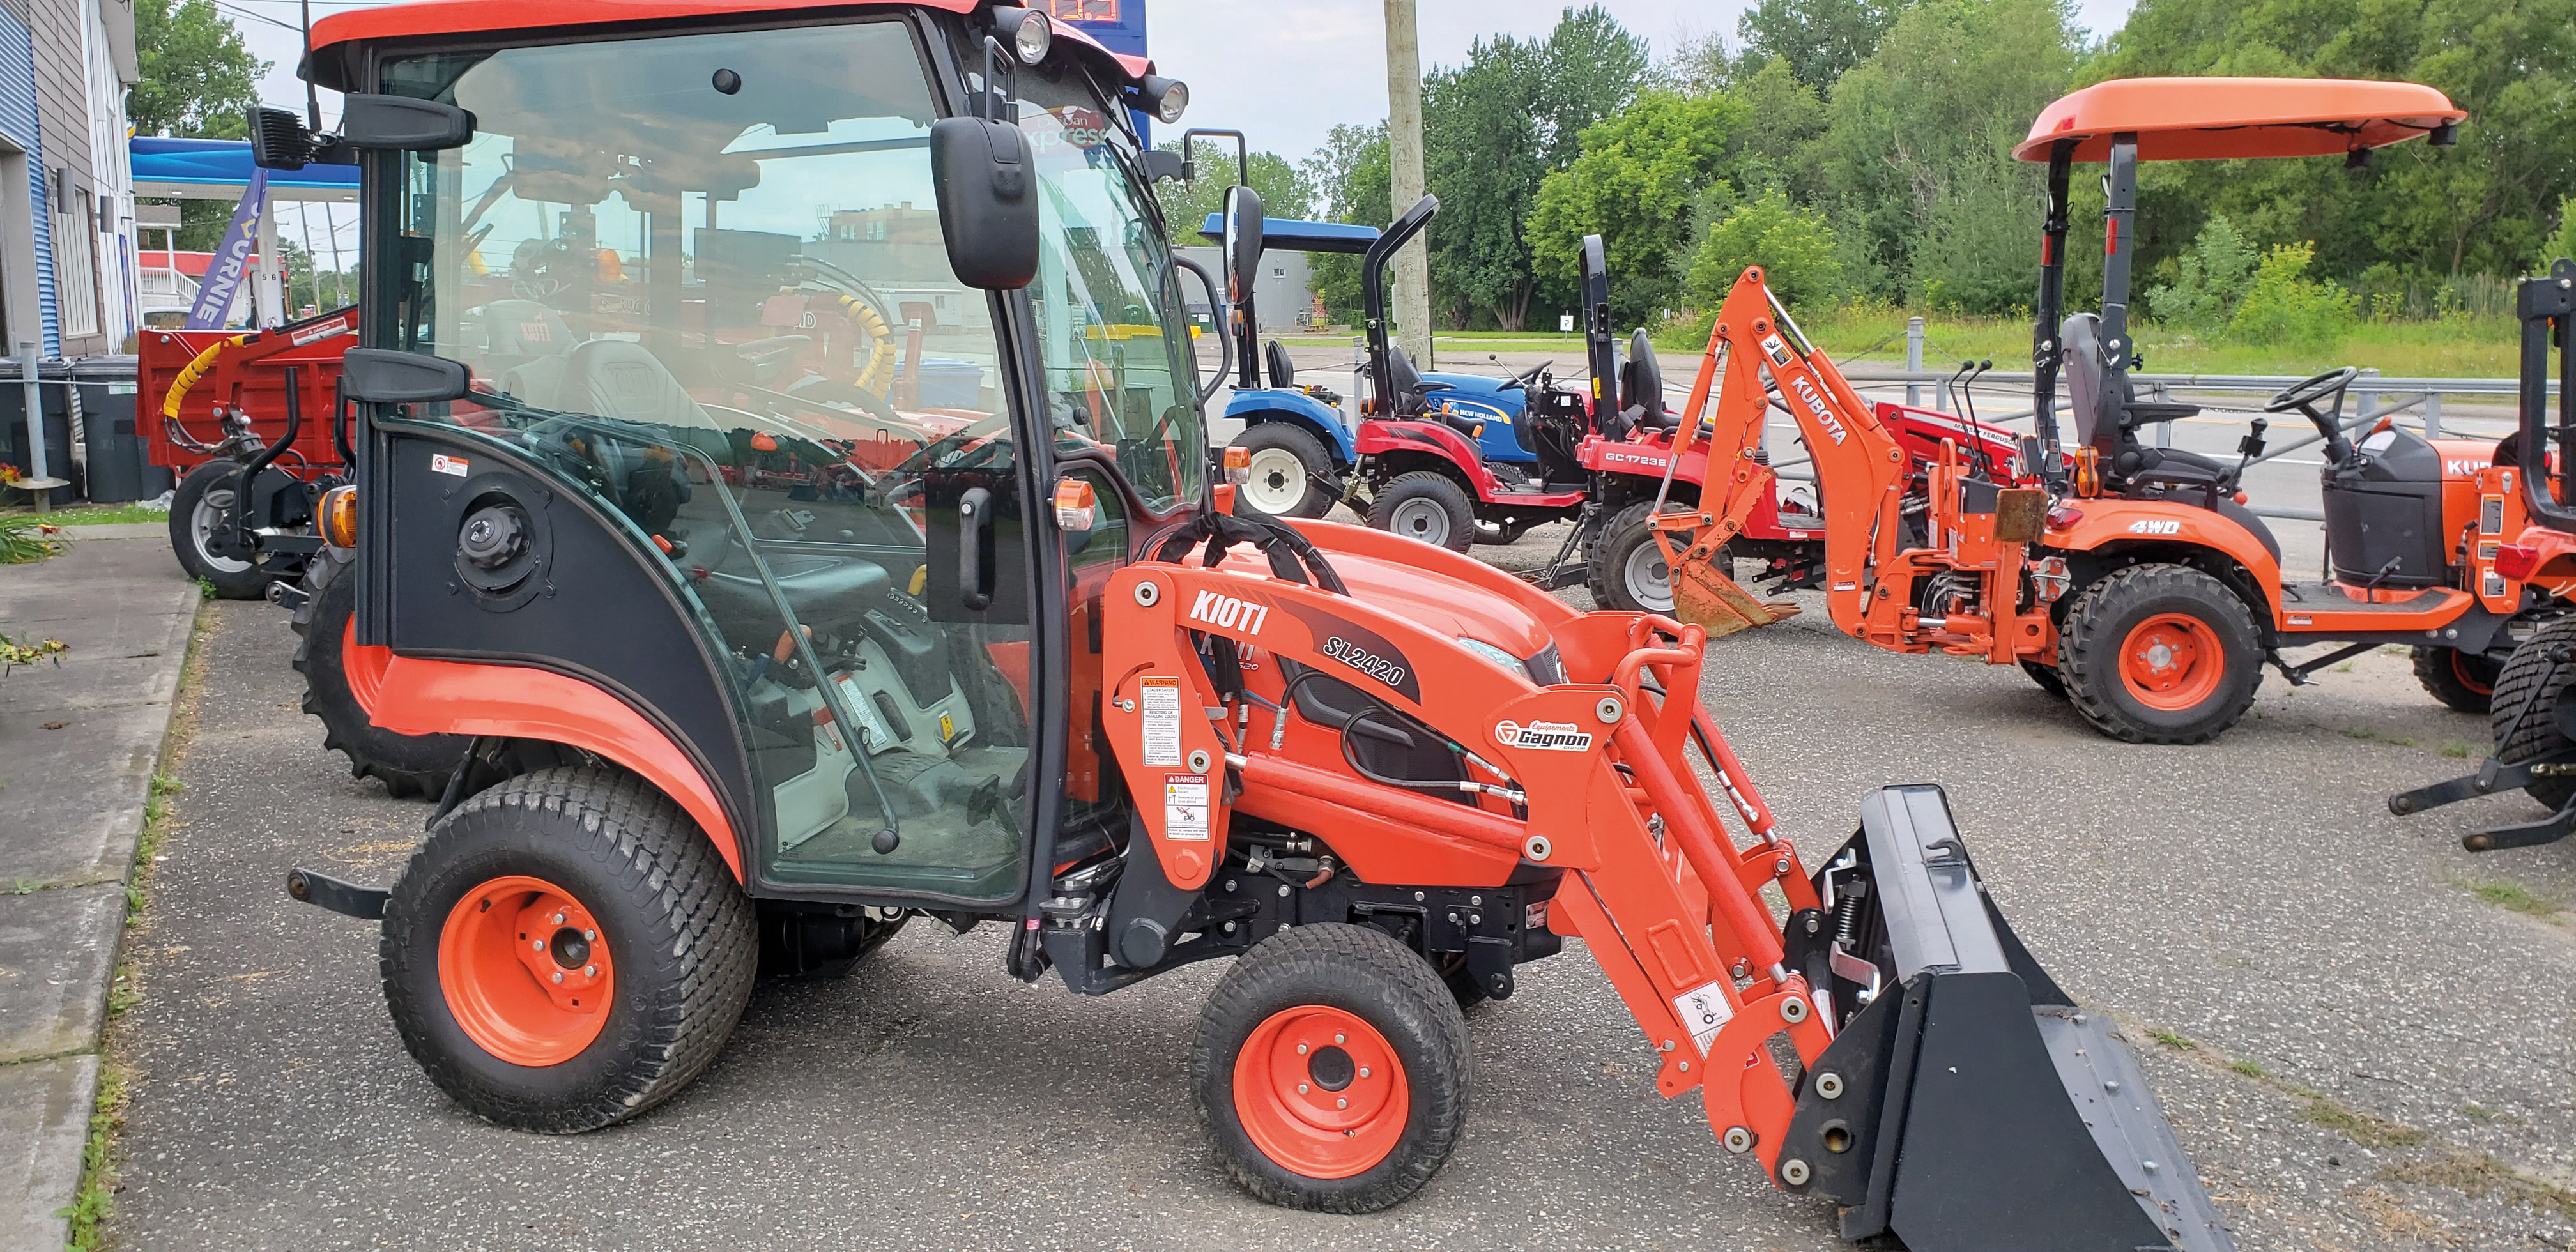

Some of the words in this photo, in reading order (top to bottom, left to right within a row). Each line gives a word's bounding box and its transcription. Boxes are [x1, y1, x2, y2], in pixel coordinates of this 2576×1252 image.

[1024, 128, 1106, 153] xpress
[1475, 411, 1502, 422] HOLLAND
[1791, 375, 1848, 447] KUBOTA
[2128, 521, 2181, 534] 4WD
[1190, 590, 1269, 636] KIOTI
[1323, 636, 1405, 686] SL2420
[1519, 731, 1590, 747] Gagnon
